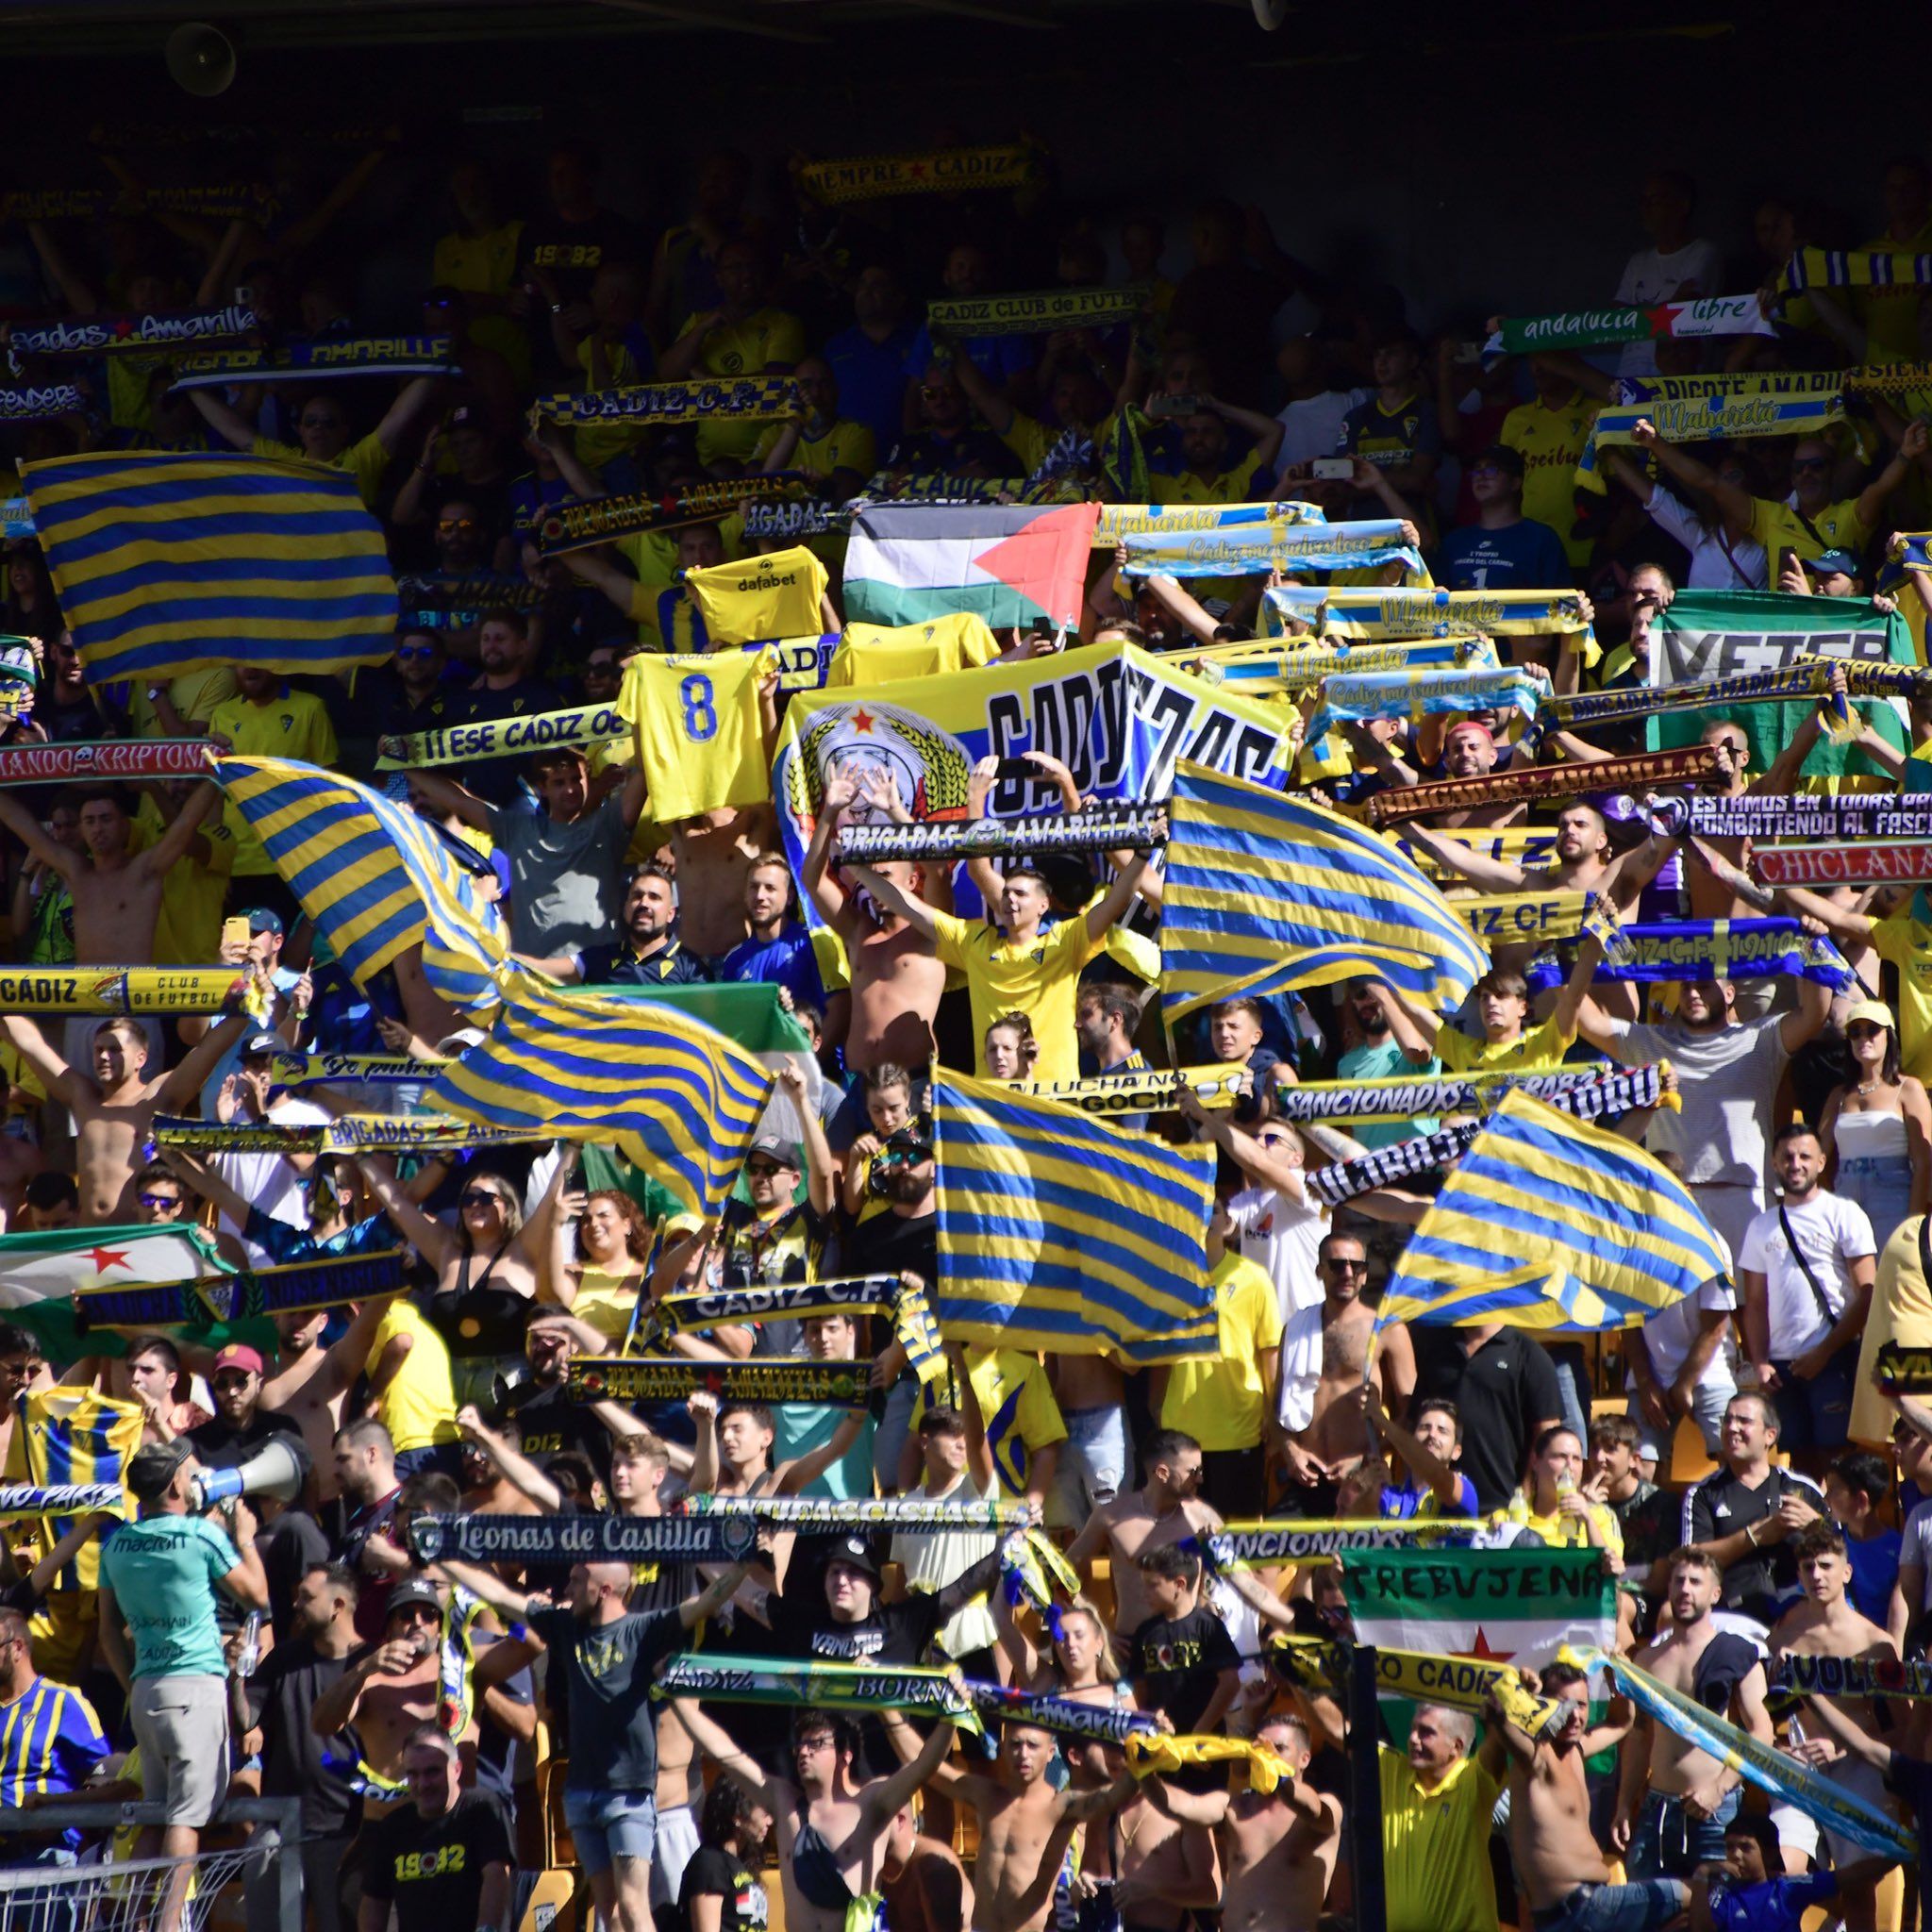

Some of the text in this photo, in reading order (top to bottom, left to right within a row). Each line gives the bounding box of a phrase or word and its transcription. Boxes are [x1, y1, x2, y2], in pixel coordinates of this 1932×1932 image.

[996, 295, 1046, 316] CLUB
[1053, 295, 1074, 312] de
[577, 385, 688, 417] CADIZ
[745, 499, 830, 532] IGADAS
[738, 573, 796, 591] dafabet
[1706, 667, 1816, 700] AMARILLAS
[678, 674, 717, 743] 8
[1692, 795, 1789, 813] ESTAMOS
[1795, 795, 1818, 812] EN
[1830, 793, 1896, 812] TODAS
[841, 811, 1156, 851] BRIGADAS AMARILLAS
[1690, 813, 1838, 836] COMBATIENDO
[1844, 812, 1871, 835] AL
[1514, 901, 1561, 932] CF
[1730, 930, 1795, 964] 1910
[1, 974, 199, 1003] CÁDIZ CLUB
[134, 993, 217, 1005] DE FUTBOL
[1148, 1072, 1188, 1086] NO
[330, 1120, 425, 1144] BRIGADAS
[696, 1276, 884, 1318] CADIZ C.F.
[707, 1497, 991, 1522] ANTIFASCISTAS
[453, 1516, 712, 1559] Leonas de Castilla
[1417, 1658, 1505, 1696] CADIZ
